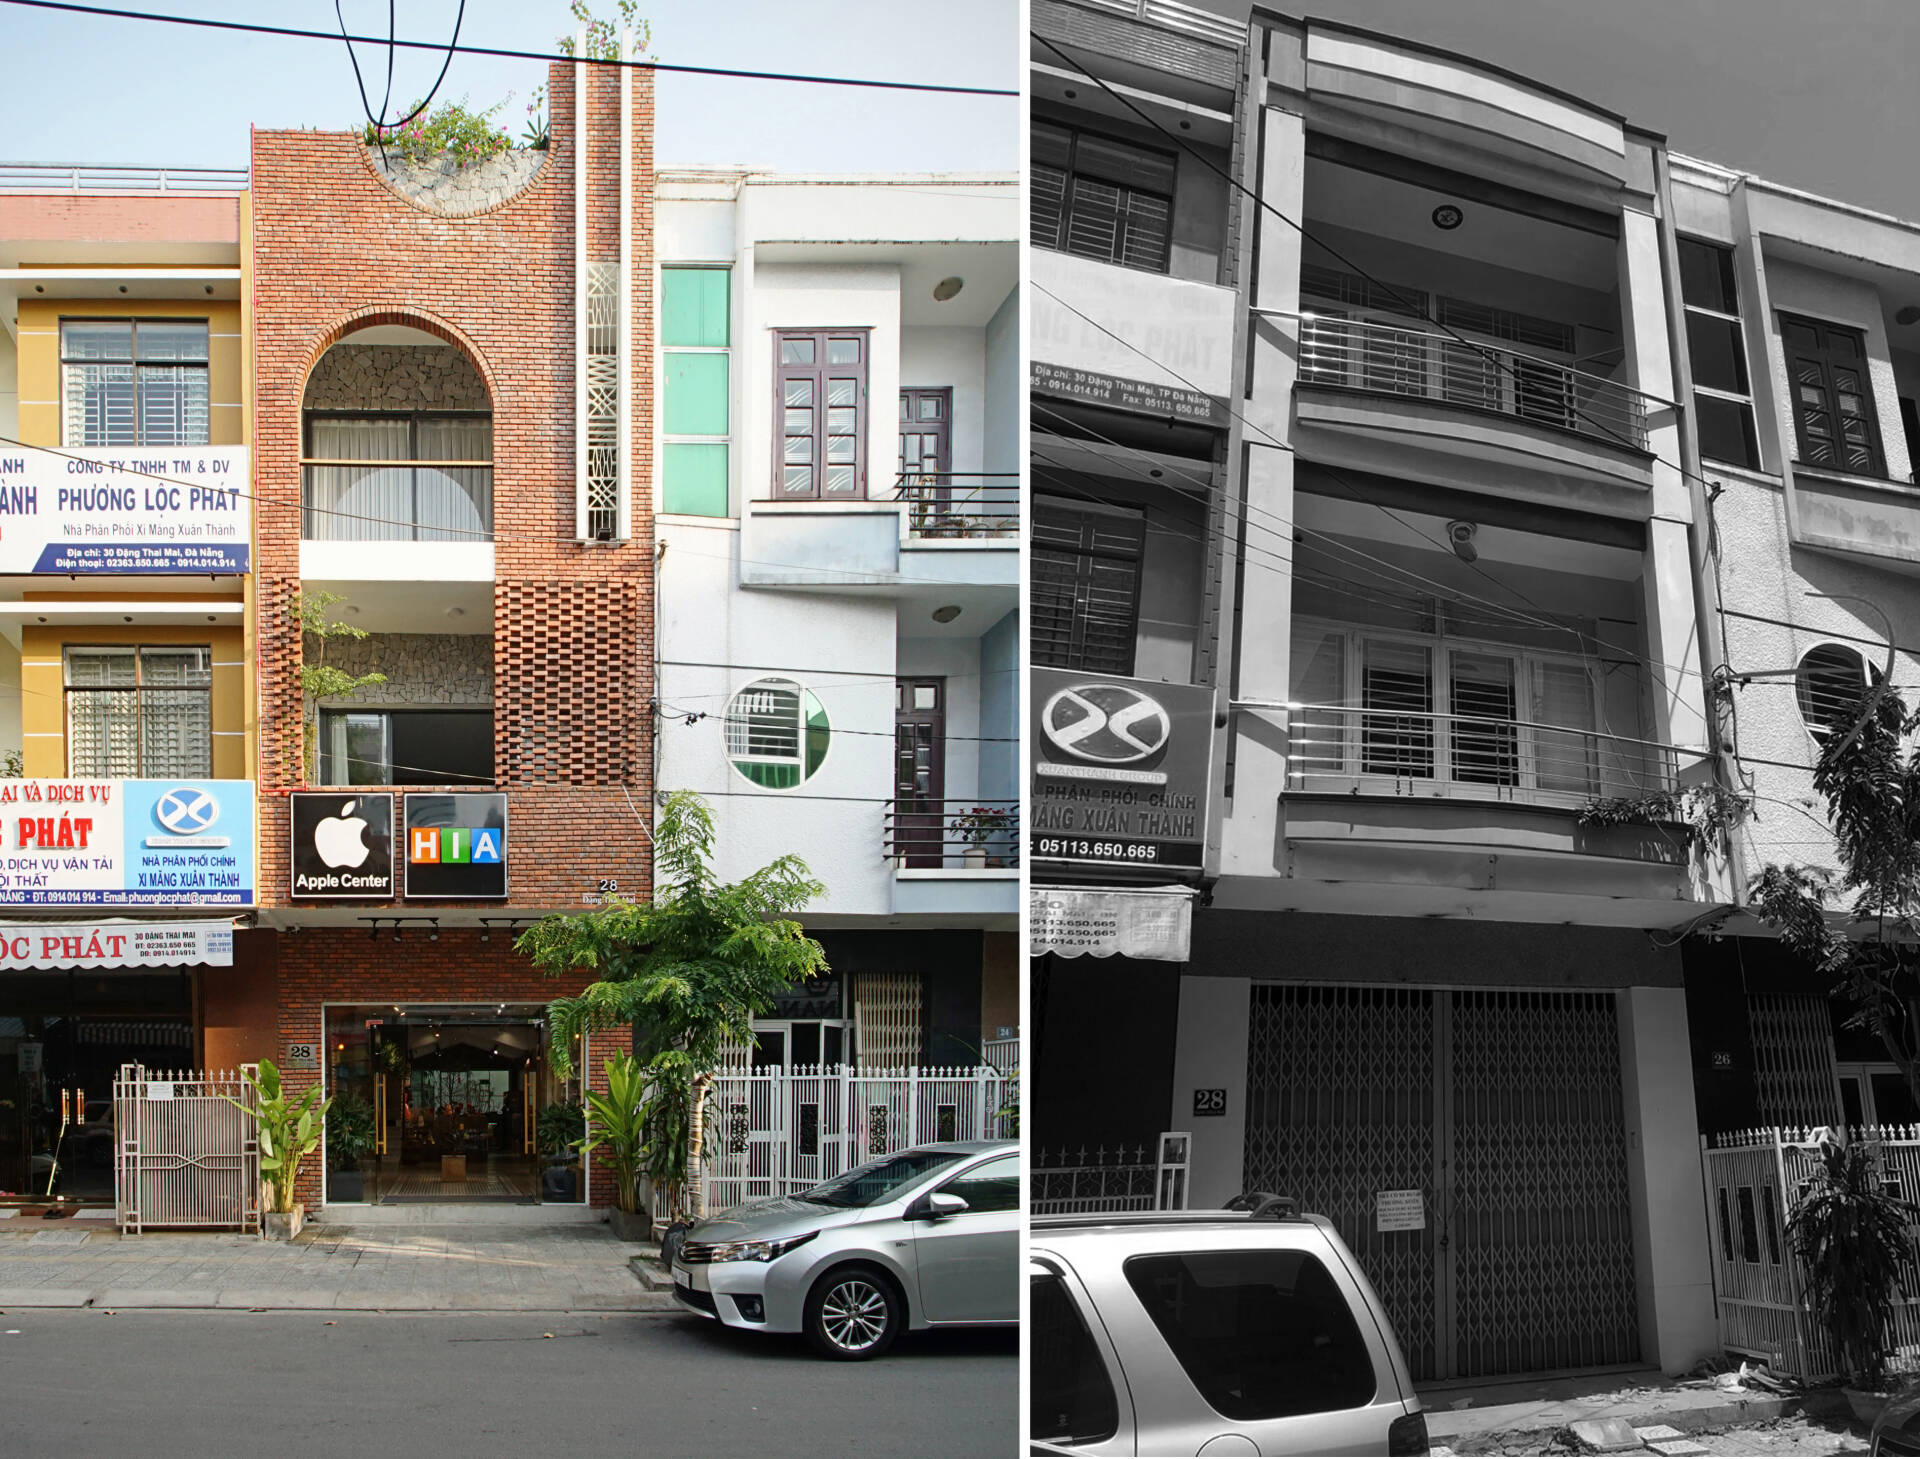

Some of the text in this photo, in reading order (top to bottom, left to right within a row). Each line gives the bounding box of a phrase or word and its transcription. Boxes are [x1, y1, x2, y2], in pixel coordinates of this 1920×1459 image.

[1049, 379, 1110, 399] 0914.014.914
[1122, 393, 1142, 405] Fax:
[1074, 372, 1086, 382] 30
[1159, 388, 1171, 398] TP
[0, 458, 25, 474] NH
[109, 460, 127, 474] TY
[131, 460, 167, 474] TNHH
[173, 460, 191, 474] TM
[197, 459, 206, 474] &
[212, 460, 230, 474] DV
[58, 481, 240, 518] PHƯƠNG LỘC PHÁT
[137, 523, 146, 536] Xi
[66, 548, 82, 558] Địa
[103, 548, 114, 557] 30
[185, 547, 198, 557] Đà
[177, 558, 236, 568] 0914.014.914
[23, 780, 42, 801] VÀ
[48, 785, 85, 805] DỊCH
[90, 785, 111, 805] VỤ
[18, 810, 93, 847] PHÁT
[1082, 807, 1130, 833] XUÂN
[1138, 810, 1195, 837] THÀNH
[414, 830, 499, 860] HIA
[1039, 838, 1157, 859] 05113.650.665
[8, 858, 37, 873] DỊCH
[41, 858, 59, 873] VỤ
[63, 856, 89, 872] VẬN
[92, 855, 113, 870] TẢI
[142, 855, 160, 867] NHÀ
[162, 855, 187, 867] PHÂN
[210, 855, 236, 867] CHÍNH
[15, 872, 48, 886] THẤT
[138, 870, 240, 888] XI MĂNG XUÂN THÀNH
[296, 873, 389, 891] Apple Center
[600, 879, 617, 892] 28
[47, 891, 66, 903] 0914
[67, 891, 81, 903] 014
[82, 891, 97, 903] 914
[182, 931, 196, 939] MAI
[1030, 937, 1101, 946] 14.014.914
[40, 929, 127, 960] PHÁT
[291, 1045, 310, 1058] 28
[1196, 1090, 1224, 1110] 28
